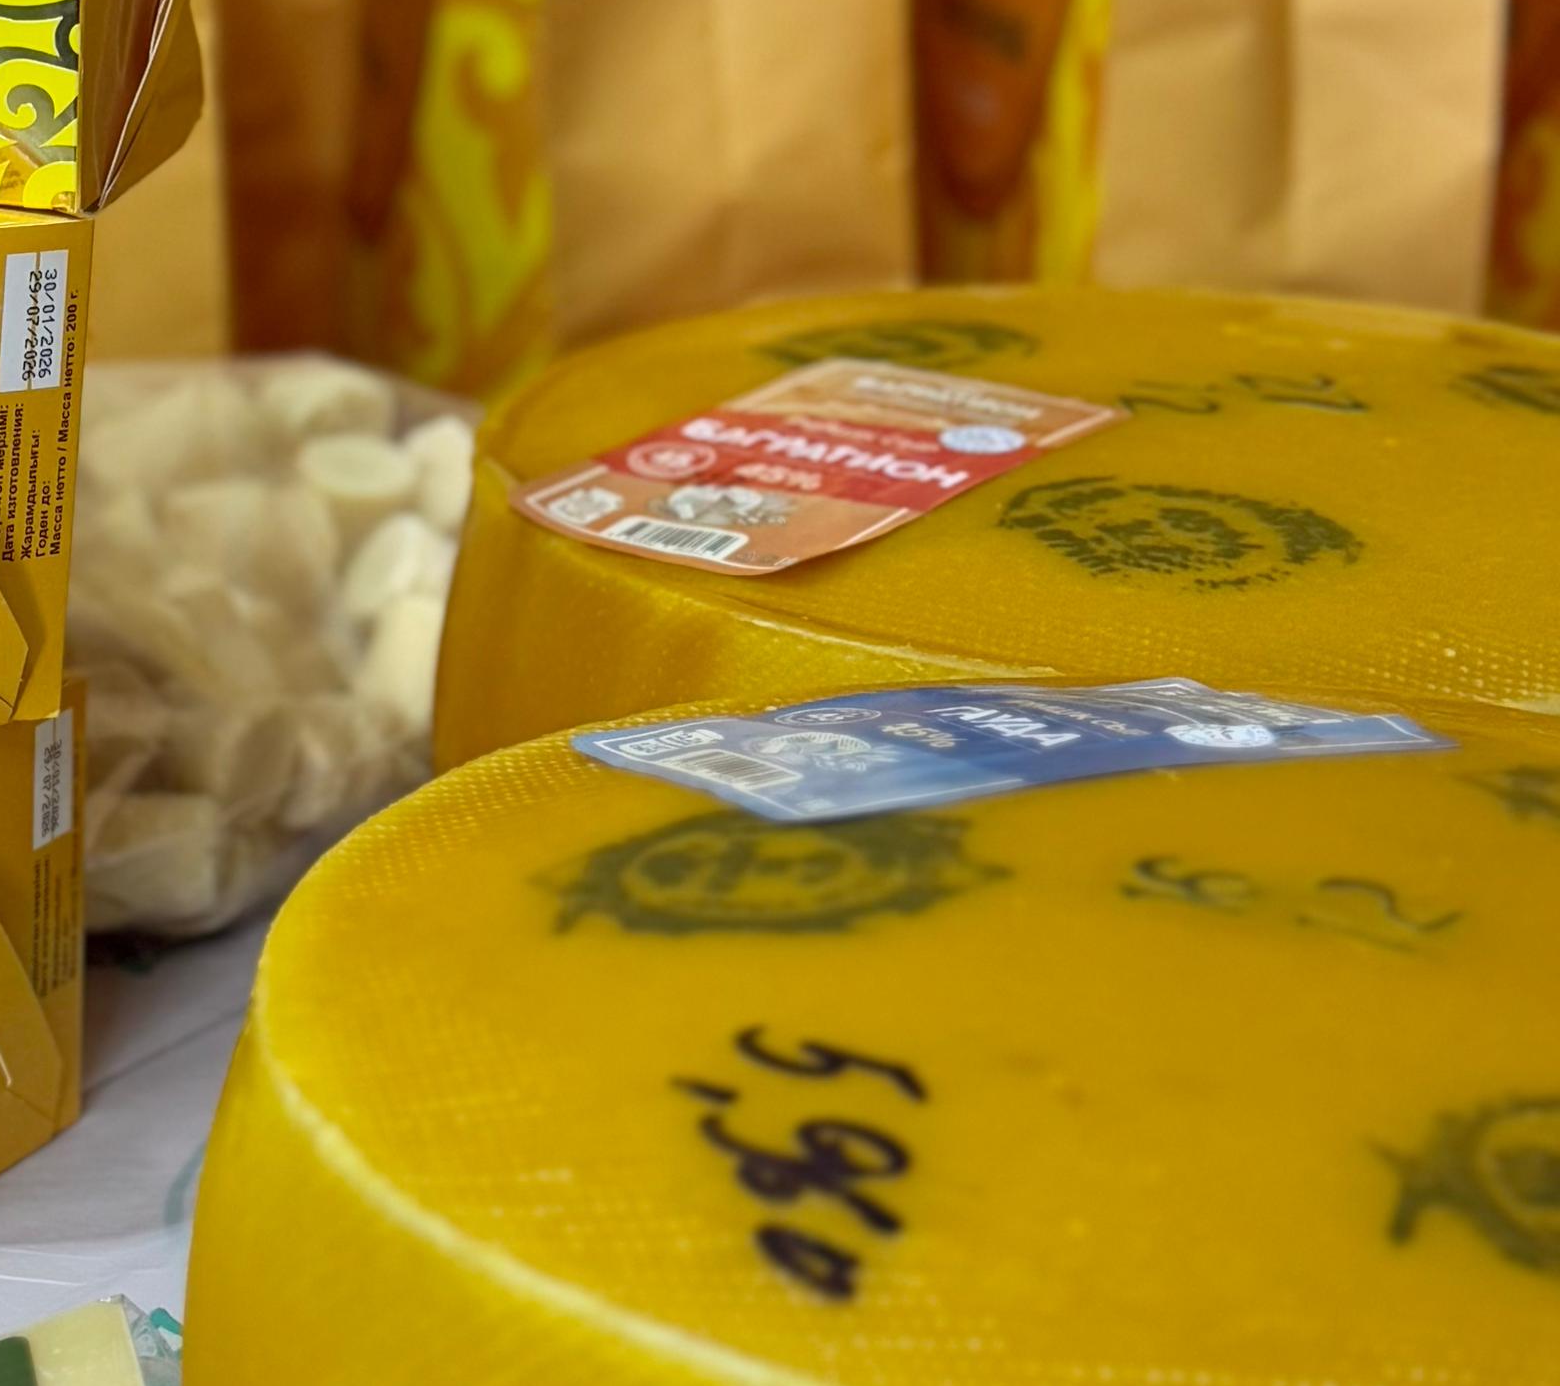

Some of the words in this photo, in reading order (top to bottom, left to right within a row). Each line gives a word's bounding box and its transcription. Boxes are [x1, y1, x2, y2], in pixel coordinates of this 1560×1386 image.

[22, 270, 42, 381] 29/07/2026
[38, 268, 57, 379] 30/01/2026
[8, 403, 23, 519] изготовления:
[50, 505, 63, 555] Масса
[58, 392, 71, 442] Масса
[66, 304, 77, 332] 200
[681, 417, 970, 489] БАГРАТИОН
[2, 524, 15, 562] Дата
[36, 507, 48, 557] Годен
